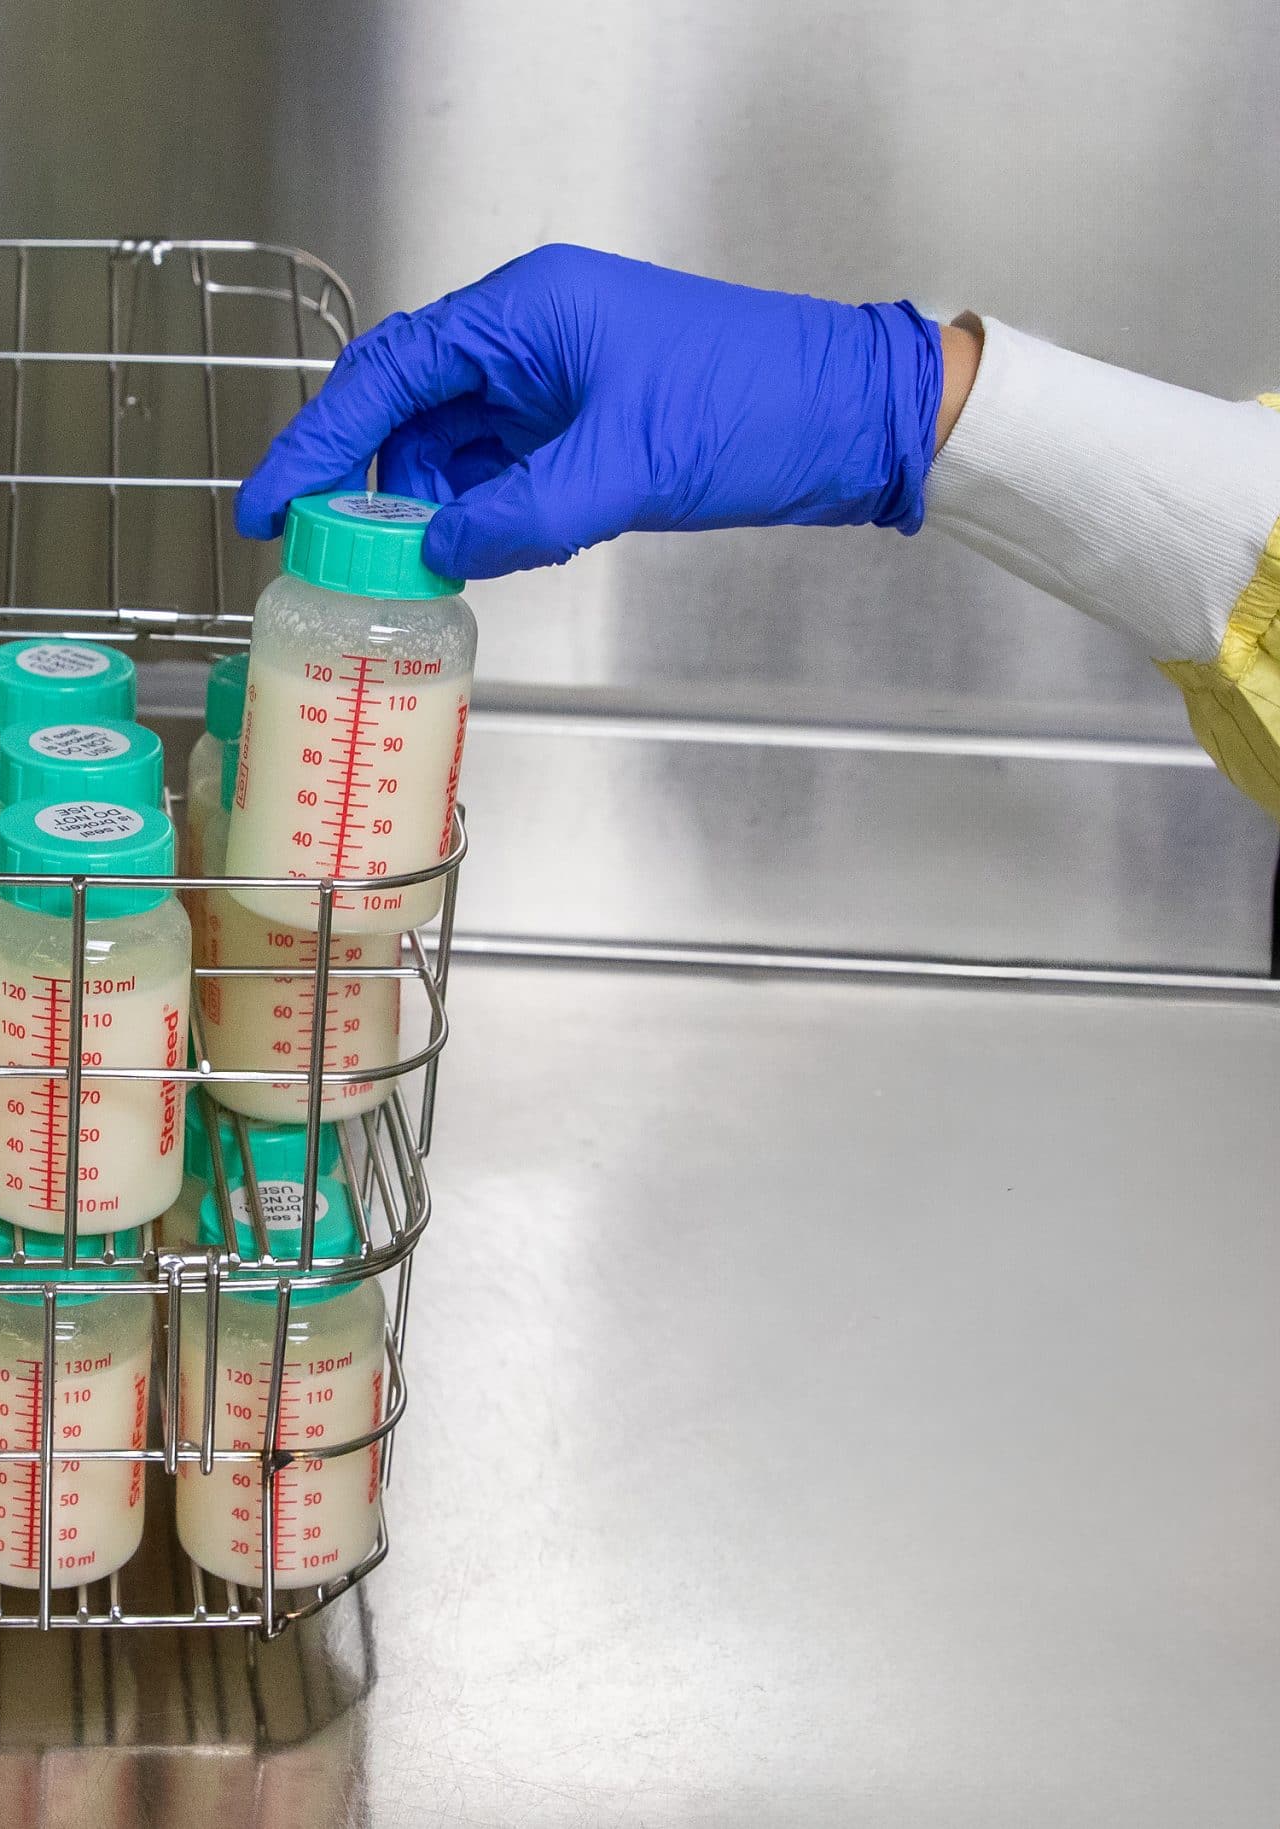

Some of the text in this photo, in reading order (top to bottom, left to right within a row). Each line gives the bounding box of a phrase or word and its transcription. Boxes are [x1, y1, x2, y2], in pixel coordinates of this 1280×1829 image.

[304, 663, 333, 682] 120
[394, 659, 441, 674] 130 ml
[389, 696, 416, 711] 110
[299, 705, 327, 723] 100
[383, 737, 403, 751] 90
[302, 749, 322, 765] 80
[378, 779, 397, 793] 70
[297, 791, 318, 806] 60
[54, 809, 122, 825] DO NOT
[55, 805, 95, 817] USE
[80, 827, 114, 837] seal
[372, 820, 392, 834] 50
[292, 832, 312, 847] 40
[367, 861, 387, 875] 30
[363, 895, 402, 910] 10 ml
[267, 934, 293, 947] 100
[2, 982, 26, 1000] 120
[84, 976, 135, 994] 130 ml
[274, 1005, 292, 1018] 60
[83, 1013, 112, 1027] 110
[2, 1020, 25, 1039] 100
[82, 1051, 102, 1065] 90
[81, 1091, 100, 1104] 70
[7, 1100, 24, 1115] 60
[80, 1129, 100, 1142] 50
[6, 1138, 23, 1152] 40
[79, 1167, 98, 1180] 30
[6, 1174, 23, 1190] 20
[78, 1197, 118, 1212] 10 ml
[65, 1354, 111, 1374] 130 ml
[309, 1352, 352, 1375] 130 ml
[227, 1368, 252, 1385] 120
[64, 1390, 91, 1403] 110
[307, 1389, 332, 1403] 110
[226, 1403, 251, 1419] 100
[63, 1425, 81, 1438] 90
[306, 1424, 324, 1438] 90
[306, 1460, 322, 1471] 70
[232, 1474, 250, 1487] 60
[60, 1493, 78, 1506] 50
[303, 1493, 322, 1506] 50
[59, 1528, 77, 1540] 30
[302, 1526, 321, 1540] 30
